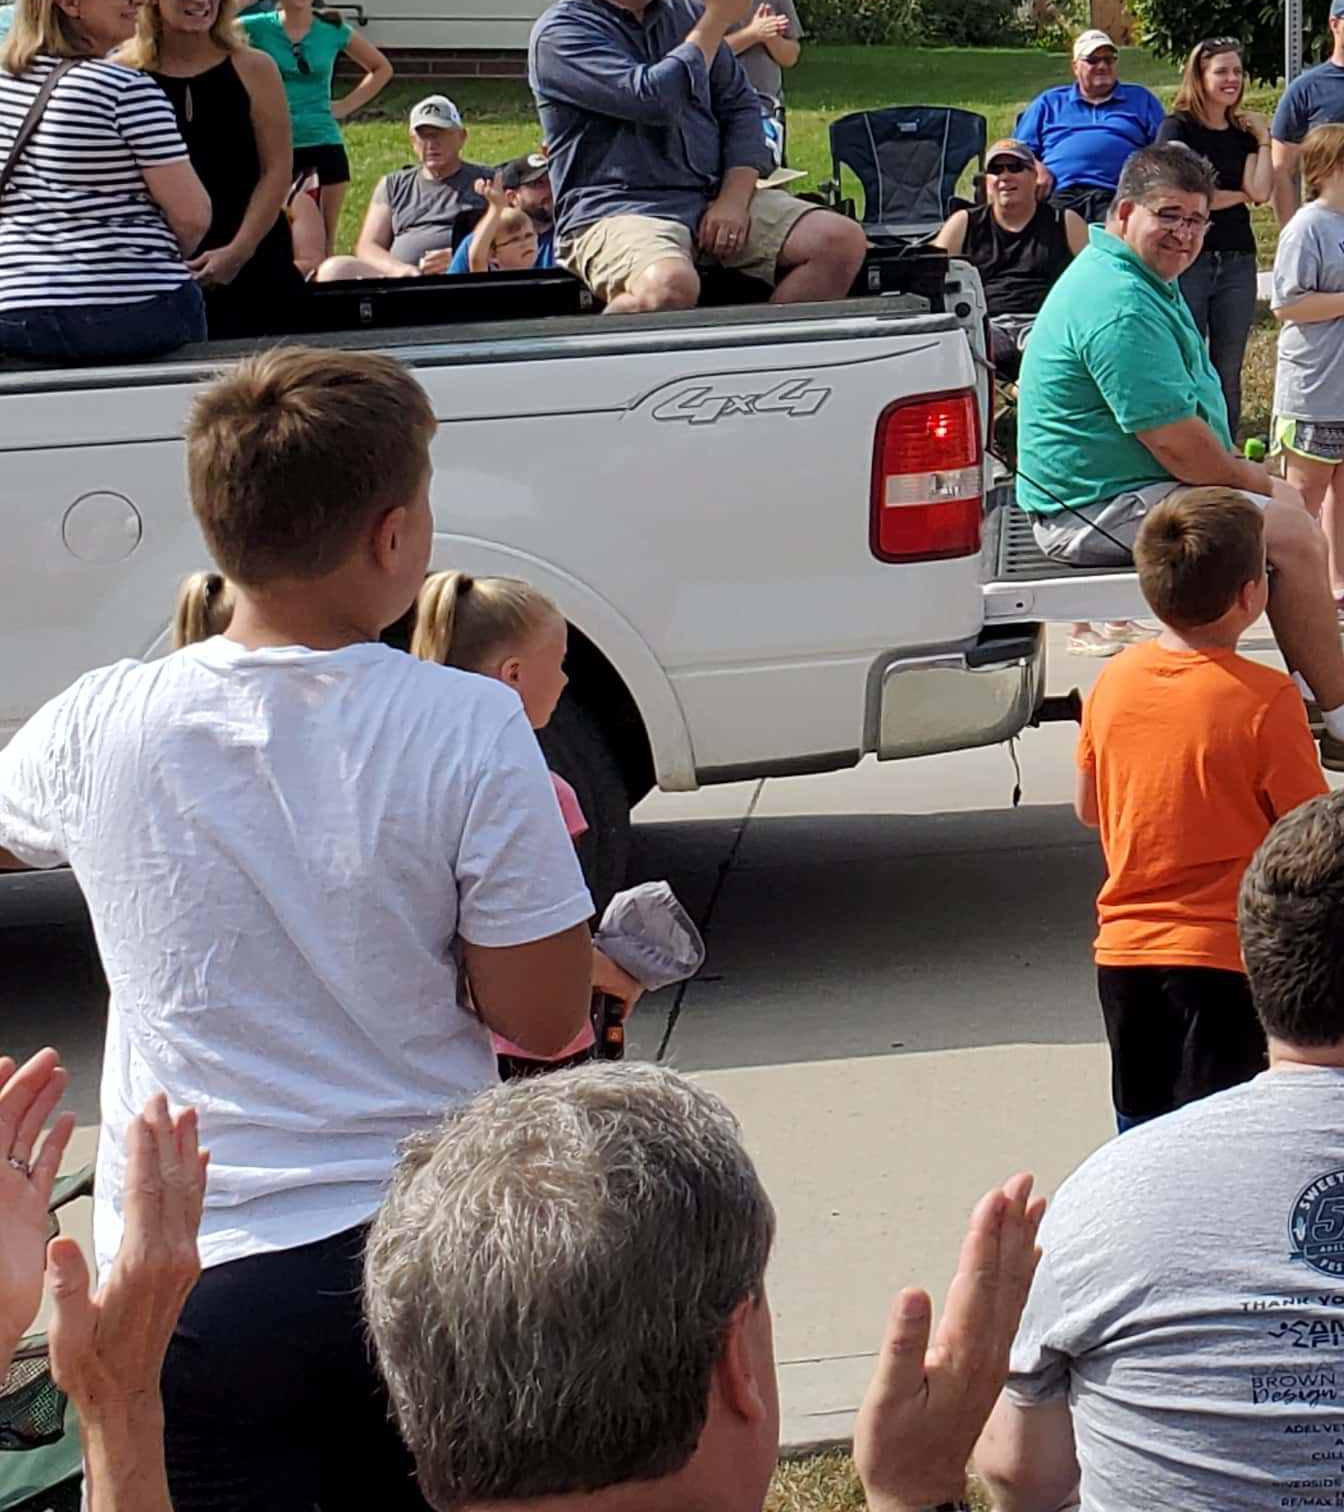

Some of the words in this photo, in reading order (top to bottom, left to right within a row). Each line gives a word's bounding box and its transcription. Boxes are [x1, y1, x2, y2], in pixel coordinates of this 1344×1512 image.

[652, 378, 832, 424] 4x4
[1240, 1296, 1310, 1312] THANK
[1251, 1373, 1336, 1388] BROWN
[1252, 1388, 1337, 1408] Design
[1284, 1422, 1321, 1434] ADEL
[1272, 1477, 1342, 1489] IVERSIDE
